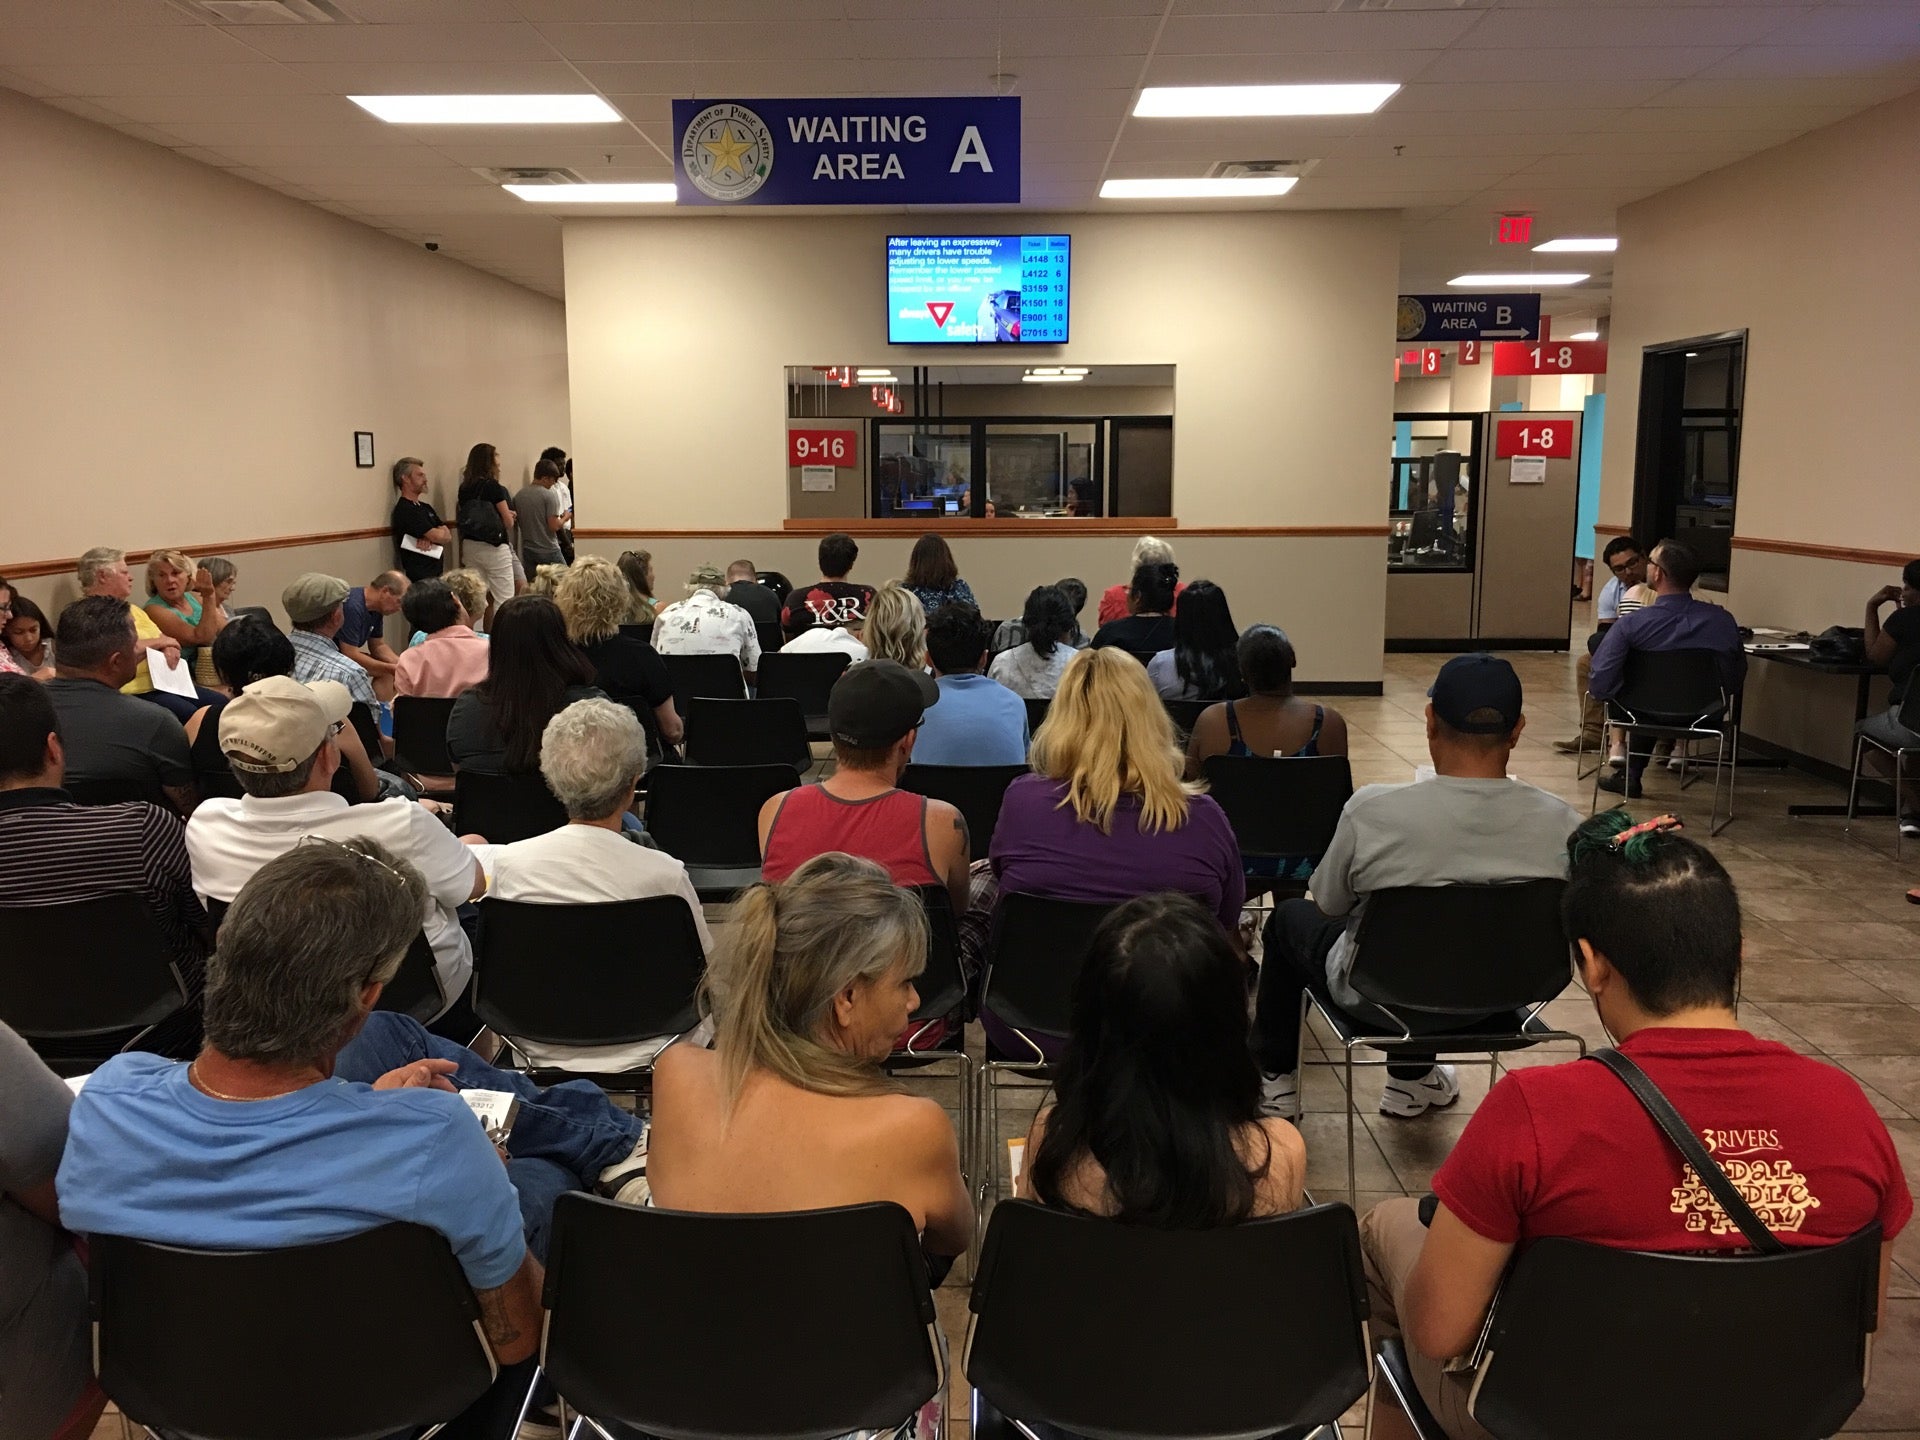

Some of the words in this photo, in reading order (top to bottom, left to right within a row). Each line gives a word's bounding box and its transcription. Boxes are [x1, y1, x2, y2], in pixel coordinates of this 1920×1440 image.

[684, 112, 713, 157] DEPARTMENT
[714, 108, 723, 116] OF
[730, 106, 757, 127] PUBLIC
[755, 128, 769, 160] SAFETY
[787, 115, 927, 143] WAITING
[949, 125, 994, 174] A
[812, 153, 905, 180] AREA
[1499, 217, 1533, 243] EXIT
[889, 238, 909, 246] After
[910, 238, 938, 248] leaving
[952, 239, 1002, 248] expressway,
[889, 249, 911, 257] many
[913, 247, 941, 255] drivers
[889, 257, 925, 266] adjusting
[937, 257, 959, 265] lower
[961, 257, 992, 266] speeds.
[1022, 255, 1048, 263] L4148
[1054, 255, 1064, 263] 13
[1022, 270, 1048, 278] L4122
[1056, 270, 1061, 278] 6
[1022, 284, 1048, 292] S3159
[1054, 284, 1064, 292] 13
[1021, 299, 1047, 307] K1501
[1053, 299, 1063, 307] 18
[1431, 301, 1487, 313] WAITING
[1440, 318, 1477, 329] AREA
[1495, 306, 1512, 324] B
[1021, 329, 1048, 337] C7015
[1053, 329, 1063, 337] 13
[1465, 340, 1474, 361] 2
[1530, 347, 1572, 369] 1-8
[1427, 351, 1436, 372] 3
[1519, 427, 1554, 449] 1-8
[796, 437, 845, 458] 9-16
[804, 596, 867, 625] Y&R
[250, 742, 277, 761] DEFEND
[470, 1101, 495, 1109] S3212
